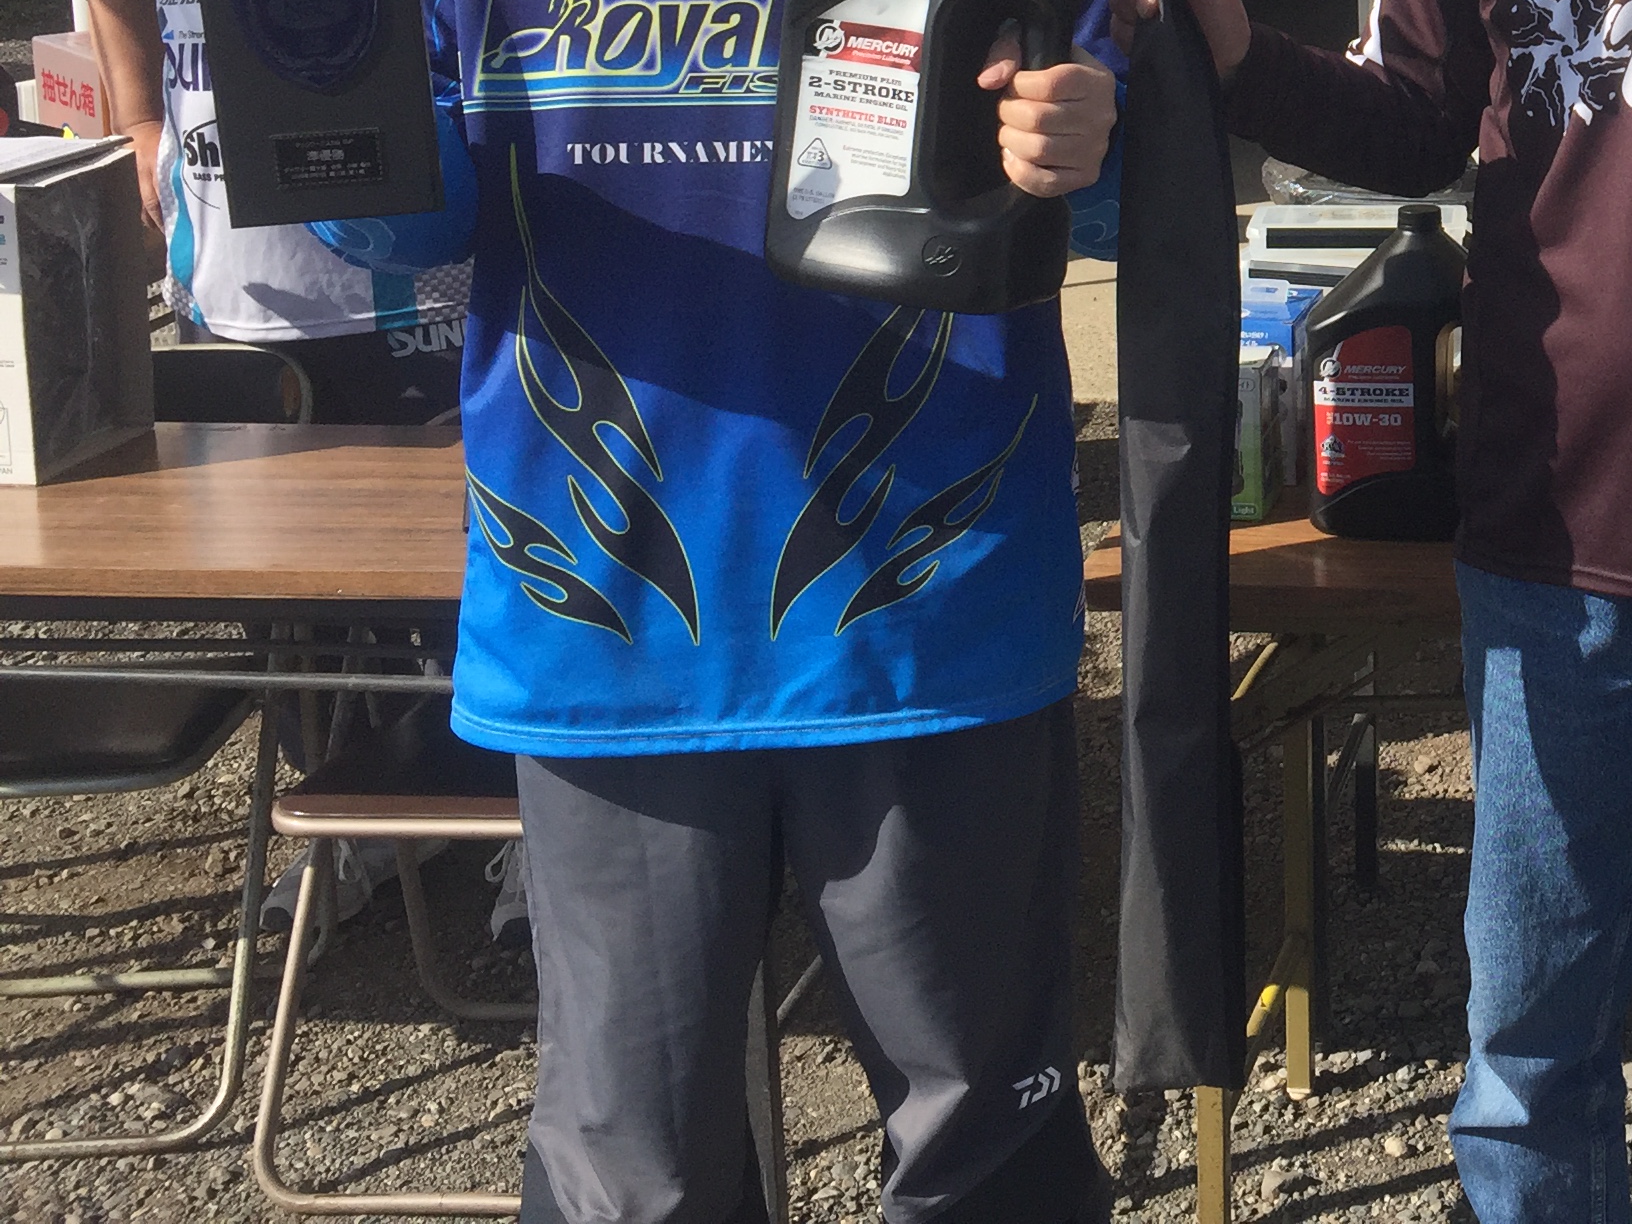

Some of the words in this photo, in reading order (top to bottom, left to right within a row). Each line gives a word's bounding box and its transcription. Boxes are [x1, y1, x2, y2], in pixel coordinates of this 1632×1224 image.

[847, 35, 920, 58] MERCURY
[829, 69, 879, 82] PREMIUM
[880, 76, 902, 87] PLUS
[41, 68, 96, 118] 抽せん箱
[808, 75, 915, 104] 2-STROKE
[814, 91, 858, 103] MARINE
[859, 97, 894, 108] ENGINE
[809, 104, 875, 124] SYNTHETIC
[877, 115, 908, 129] BLEND
[567, 140, 774, 166] TOURNAME
[1343, 364, 1407, 375] MERCURY
[1318, 385, 1410, 397] 4-STROKE
[1333, 411, 1402, 427] 10W-30
[1234, 506, 1255, 516] Light
